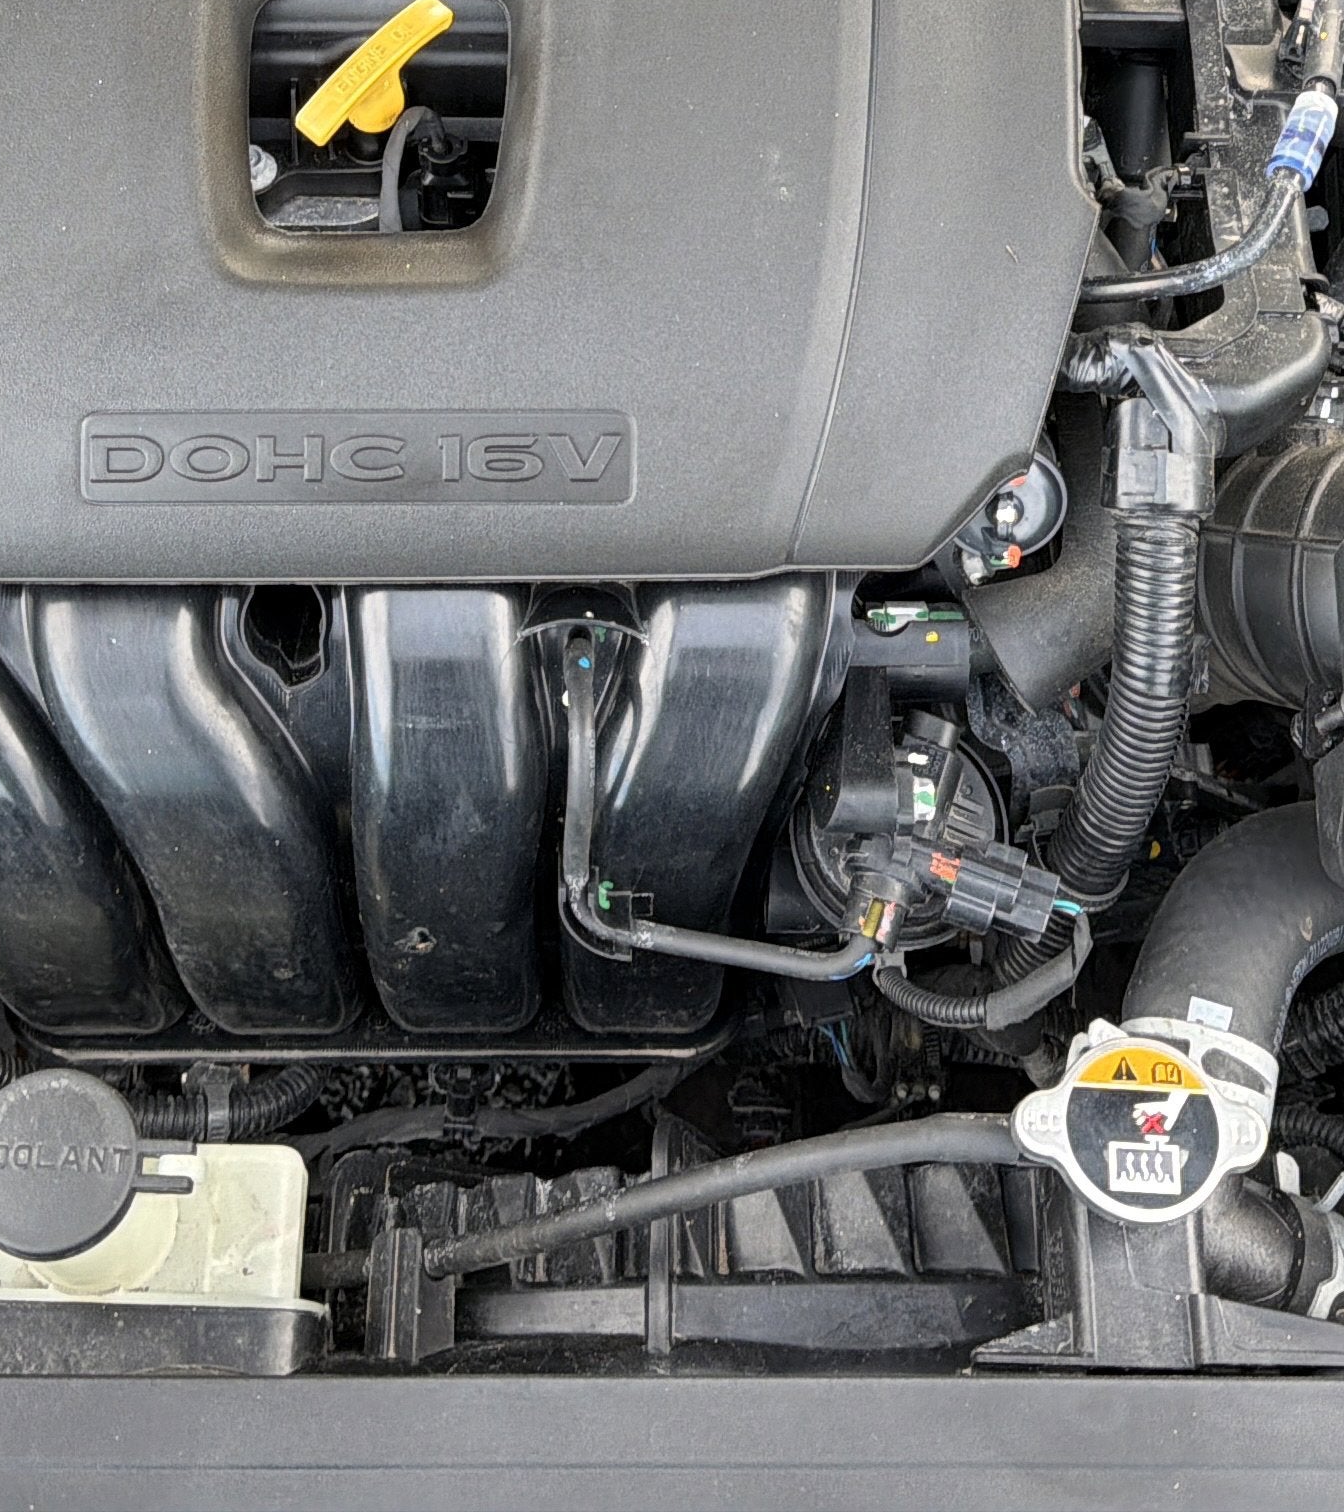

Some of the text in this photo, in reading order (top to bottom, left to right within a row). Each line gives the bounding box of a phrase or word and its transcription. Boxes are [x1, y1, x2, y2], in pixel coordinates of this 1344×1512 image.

[336, 42, 387, 94] ENGINE
[90, 434, 622, 484] DOHC 16V
